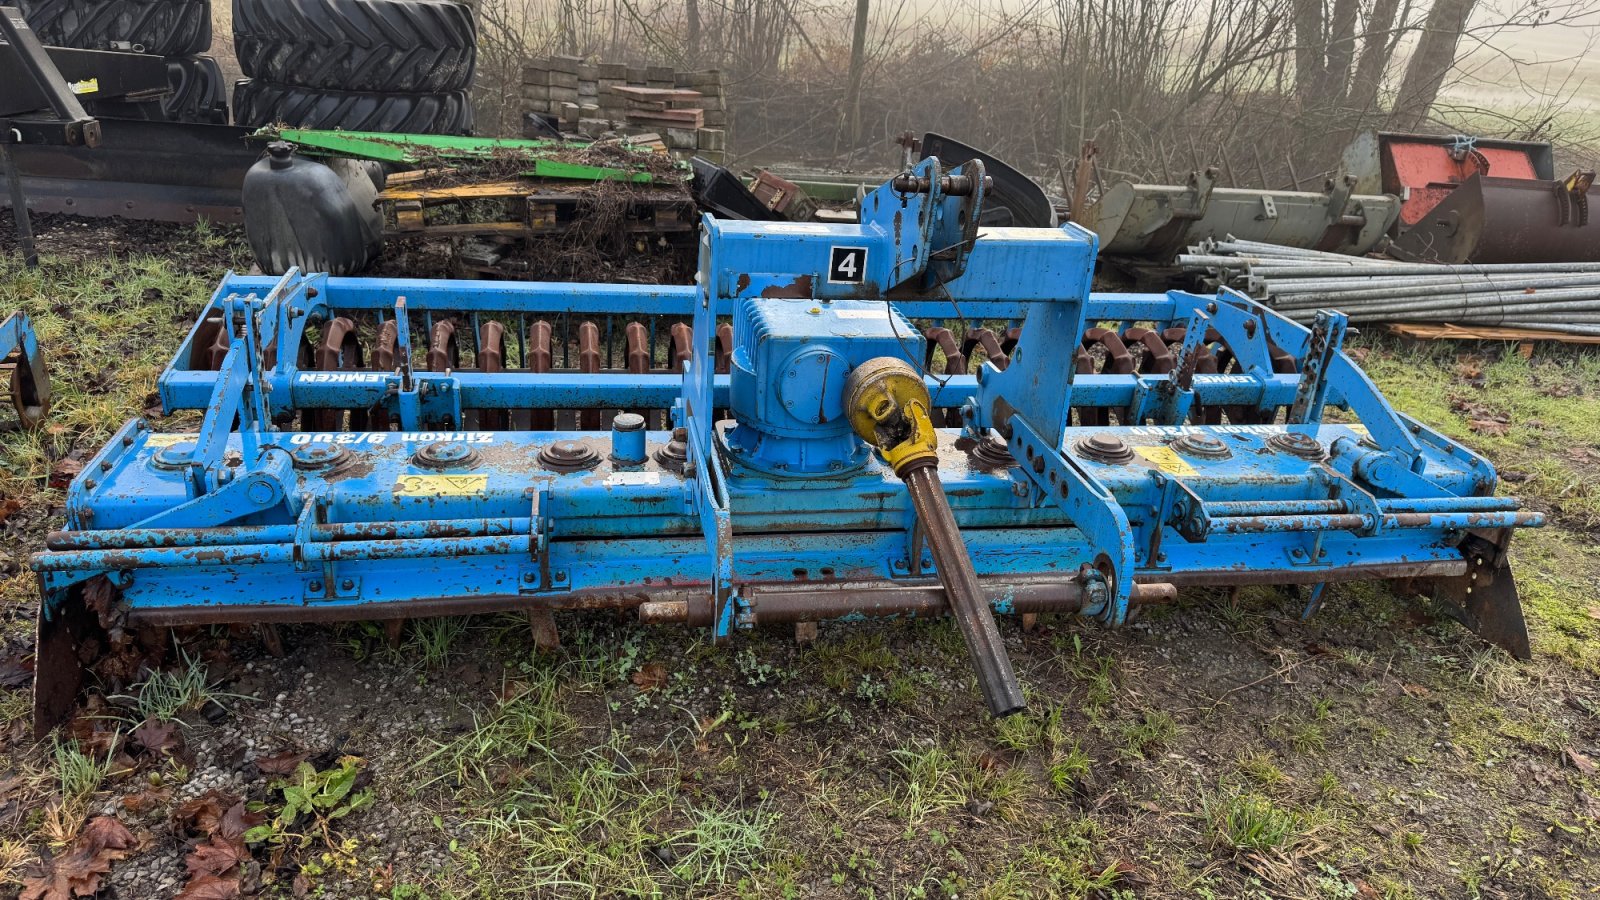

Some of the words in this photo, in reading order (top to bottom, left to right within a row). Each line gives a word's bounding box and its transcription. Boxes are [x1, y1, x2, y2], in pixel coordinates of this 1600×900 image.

[837, 252, 857, 278] 4
[299, 372, 391, 383] LEMKEN
[401, 432, 495, 444] Zirkon
